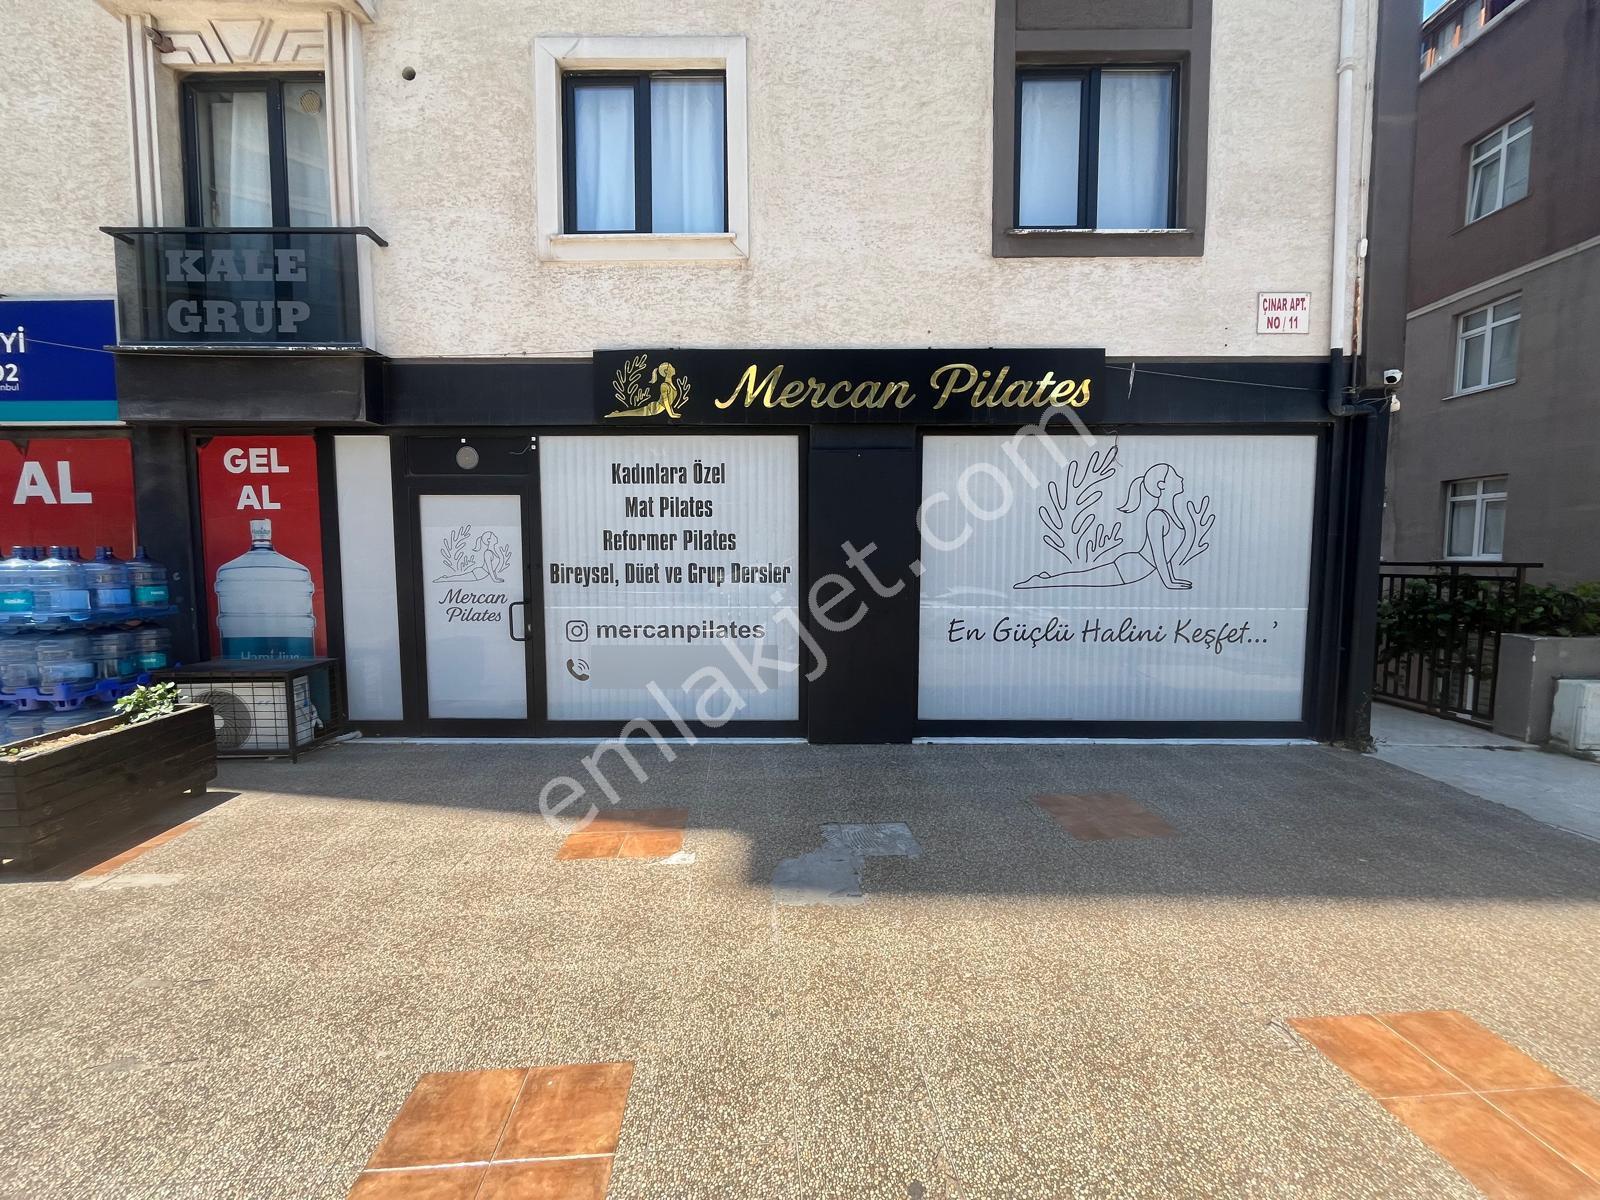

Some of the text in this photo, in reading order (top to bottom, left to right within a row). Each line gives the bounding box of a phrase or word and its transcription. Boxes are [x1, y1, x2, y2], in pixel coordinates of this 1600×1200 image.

[164, 249, 307, 282] KALE
[166, 299, 311, 334] GRUP
[1290, 297, 1307, 311] APT.
[1266, 316, 1281, 329] NO
[1288, 316, 1298, 329] 11
[714, 363, 1092, 410] Mercan Pilates
[223, 447, 290, 474] GEL
[611, 459, 726, 485] Kadınlara Özel
[13, 460, 93, 505] AL
[236, 485, 281, 510] AL
[625, 496, 713, 518] Mat Pilates
[602, 529, 737, 551] Reformer Pilates
[549, 562, 791, 587] Bireysel, Düet ve Grup Dersler
[438, 588, 508, 604] Mercan
[446, 606, 502, 623] Pilates
[596, 620, 766, 643] mercanpilates
[948, 618, 985, 643] En
[992, 616, 1075, 648] Güçlü
[1081, 617, 1167, 643] Halini
